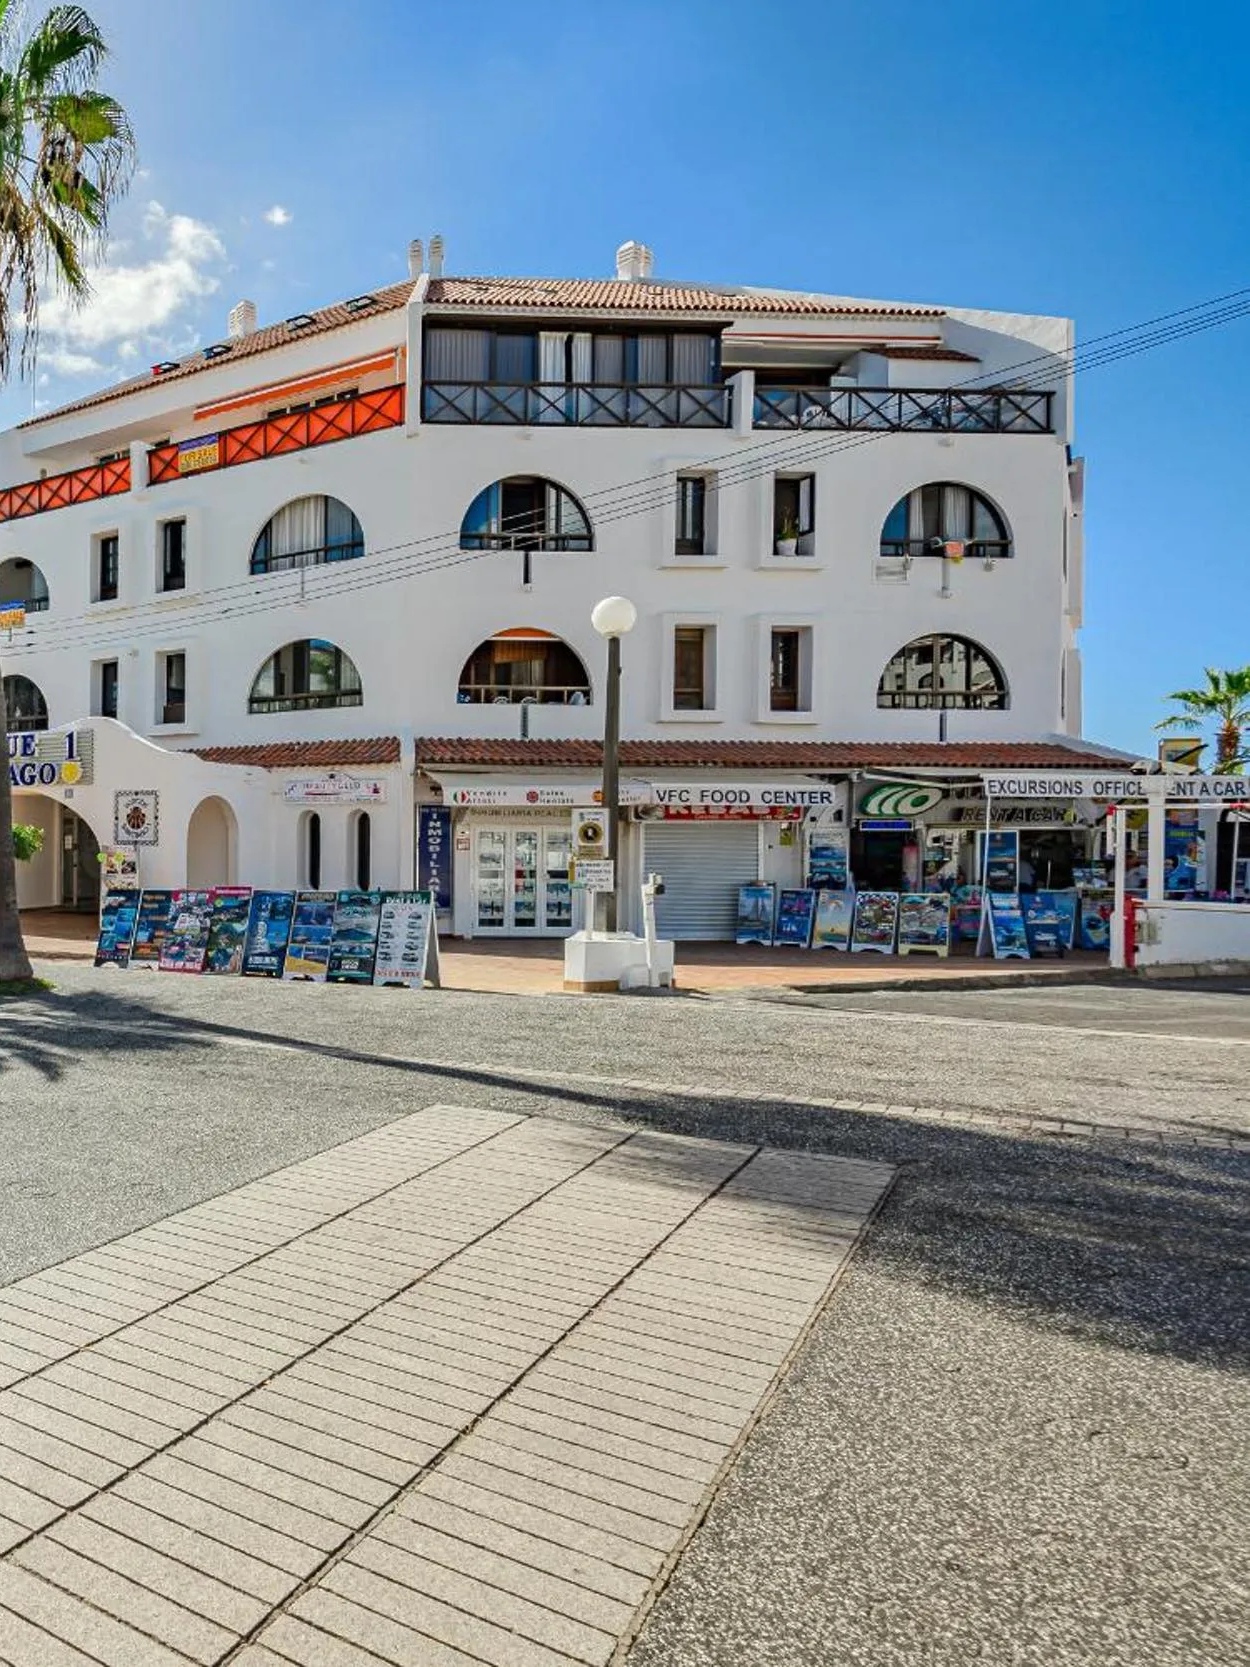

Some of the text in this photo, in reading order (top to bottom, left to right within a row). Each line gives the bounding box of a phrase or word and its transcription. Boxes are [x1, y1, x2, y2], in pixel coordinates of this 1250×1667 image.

[64, 731, 79, 761] 1
[988, 779, 1084, 795] EXCURSIONS
[1200, 782, 1212, 796] A
[1213, 781, 1246, 796] CAR
[656, 789, 690, 803] VFC
[700, 789, 751, 804] FOOD
[760, 790, 833, 805] CENTER
[962, 807, 1010, 823] RENT
